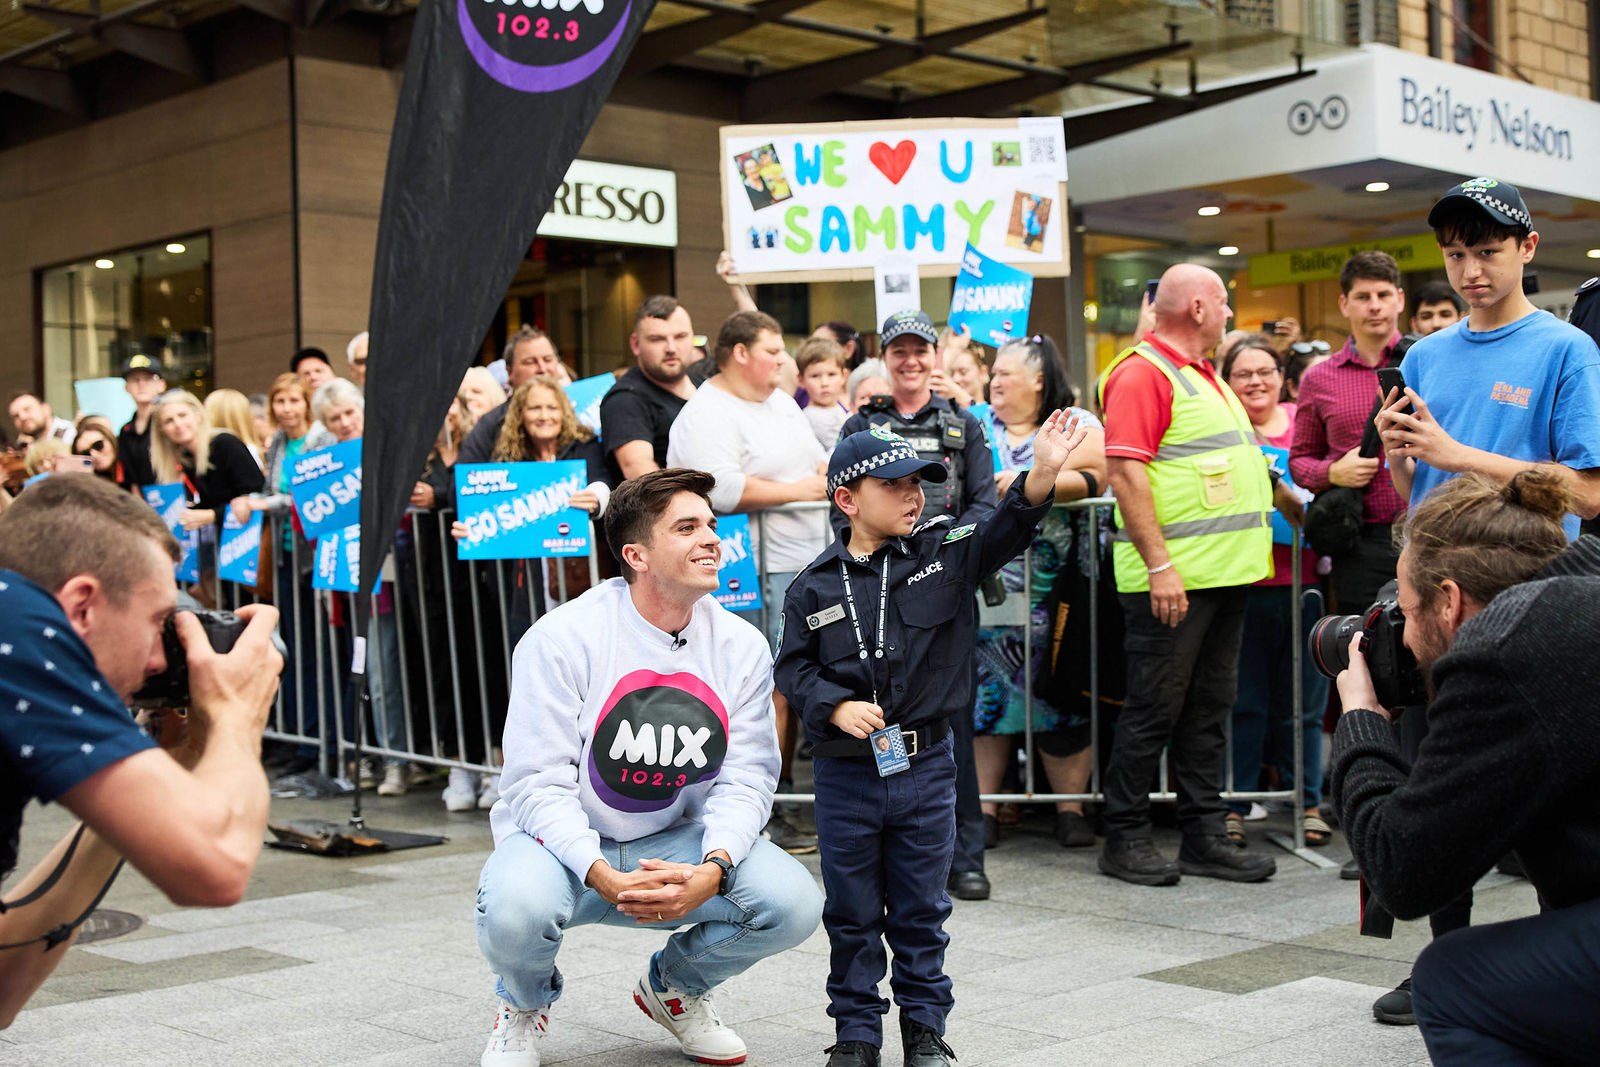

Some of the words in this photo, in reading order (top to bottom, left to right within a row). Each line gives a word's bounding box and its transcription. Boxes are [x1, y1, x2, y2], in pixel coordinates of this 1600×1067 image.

[497, 12, 580, 42] 102.3
[1400, 78, 1482, 151] Bailey
[1489, 99, 1572, 161] Nelson
[794, 140, 847, 188] WE
[940, 140, 973, 183] U
[784, 199, 996, 254] SAMMY
[302, 492, 335, 523] GO
[464, 510, 499, 543] GO
[496, 477, 579, 531] SAMMY
[907, 561, 943, 586] POLICE
[609, 719, 711, 769] MIX
[620, 768, 687, 787] 102.3
